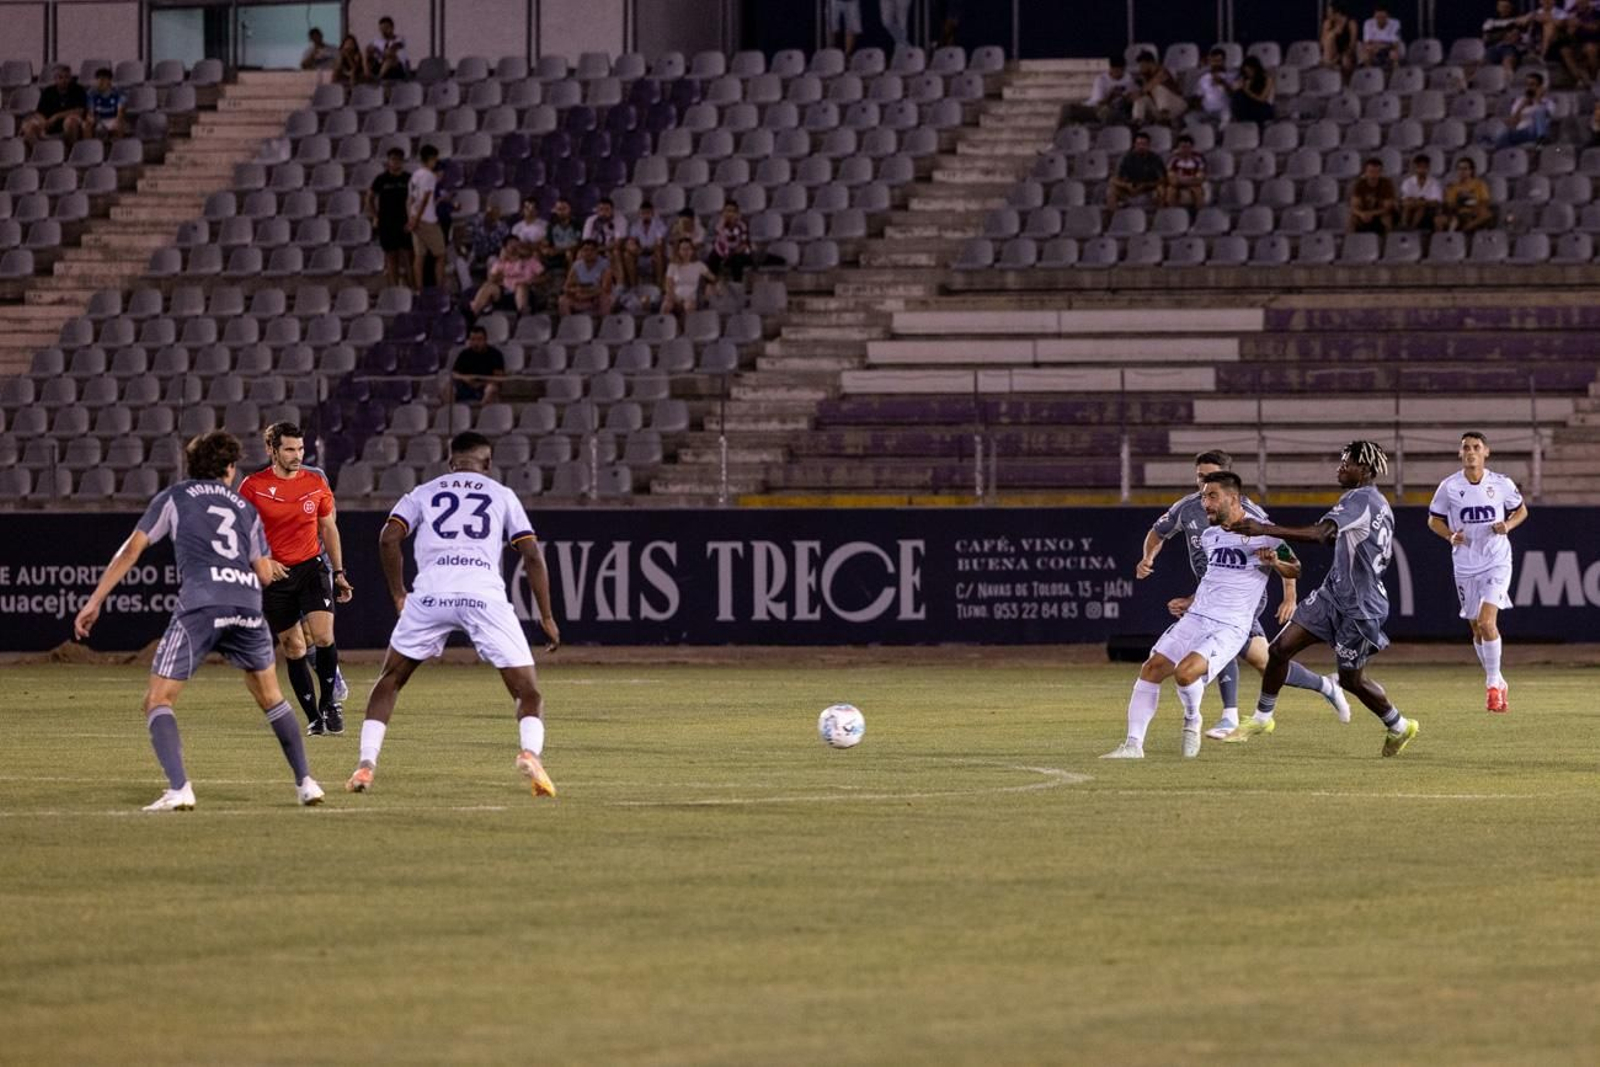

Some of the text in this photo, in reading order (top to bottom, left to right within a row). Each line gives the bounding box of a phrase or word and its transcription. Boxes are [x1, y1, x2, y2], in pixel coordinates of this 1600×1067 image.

[439, 480, 484, 491] SAKO
[430, 491, 493, 540] 23
[206, 505, 241, 561] 3
[954, 535, 1093, 554] CAFÉ, VINO Y
[436, 555, 492, 570] alderón
[957, 556, 1117, 572] BUENA COCINA
[16, 566, 158, 585] AUTORIDO
[210, 566, 260, 590] LOWI
[503, 539, 927, 623] AVAS TRECE
[0, 589, 179, 619] uacejtres.co
[438, 597, 487, 610] HYUNDAI
[1021, 602, 1038, 618] 22
